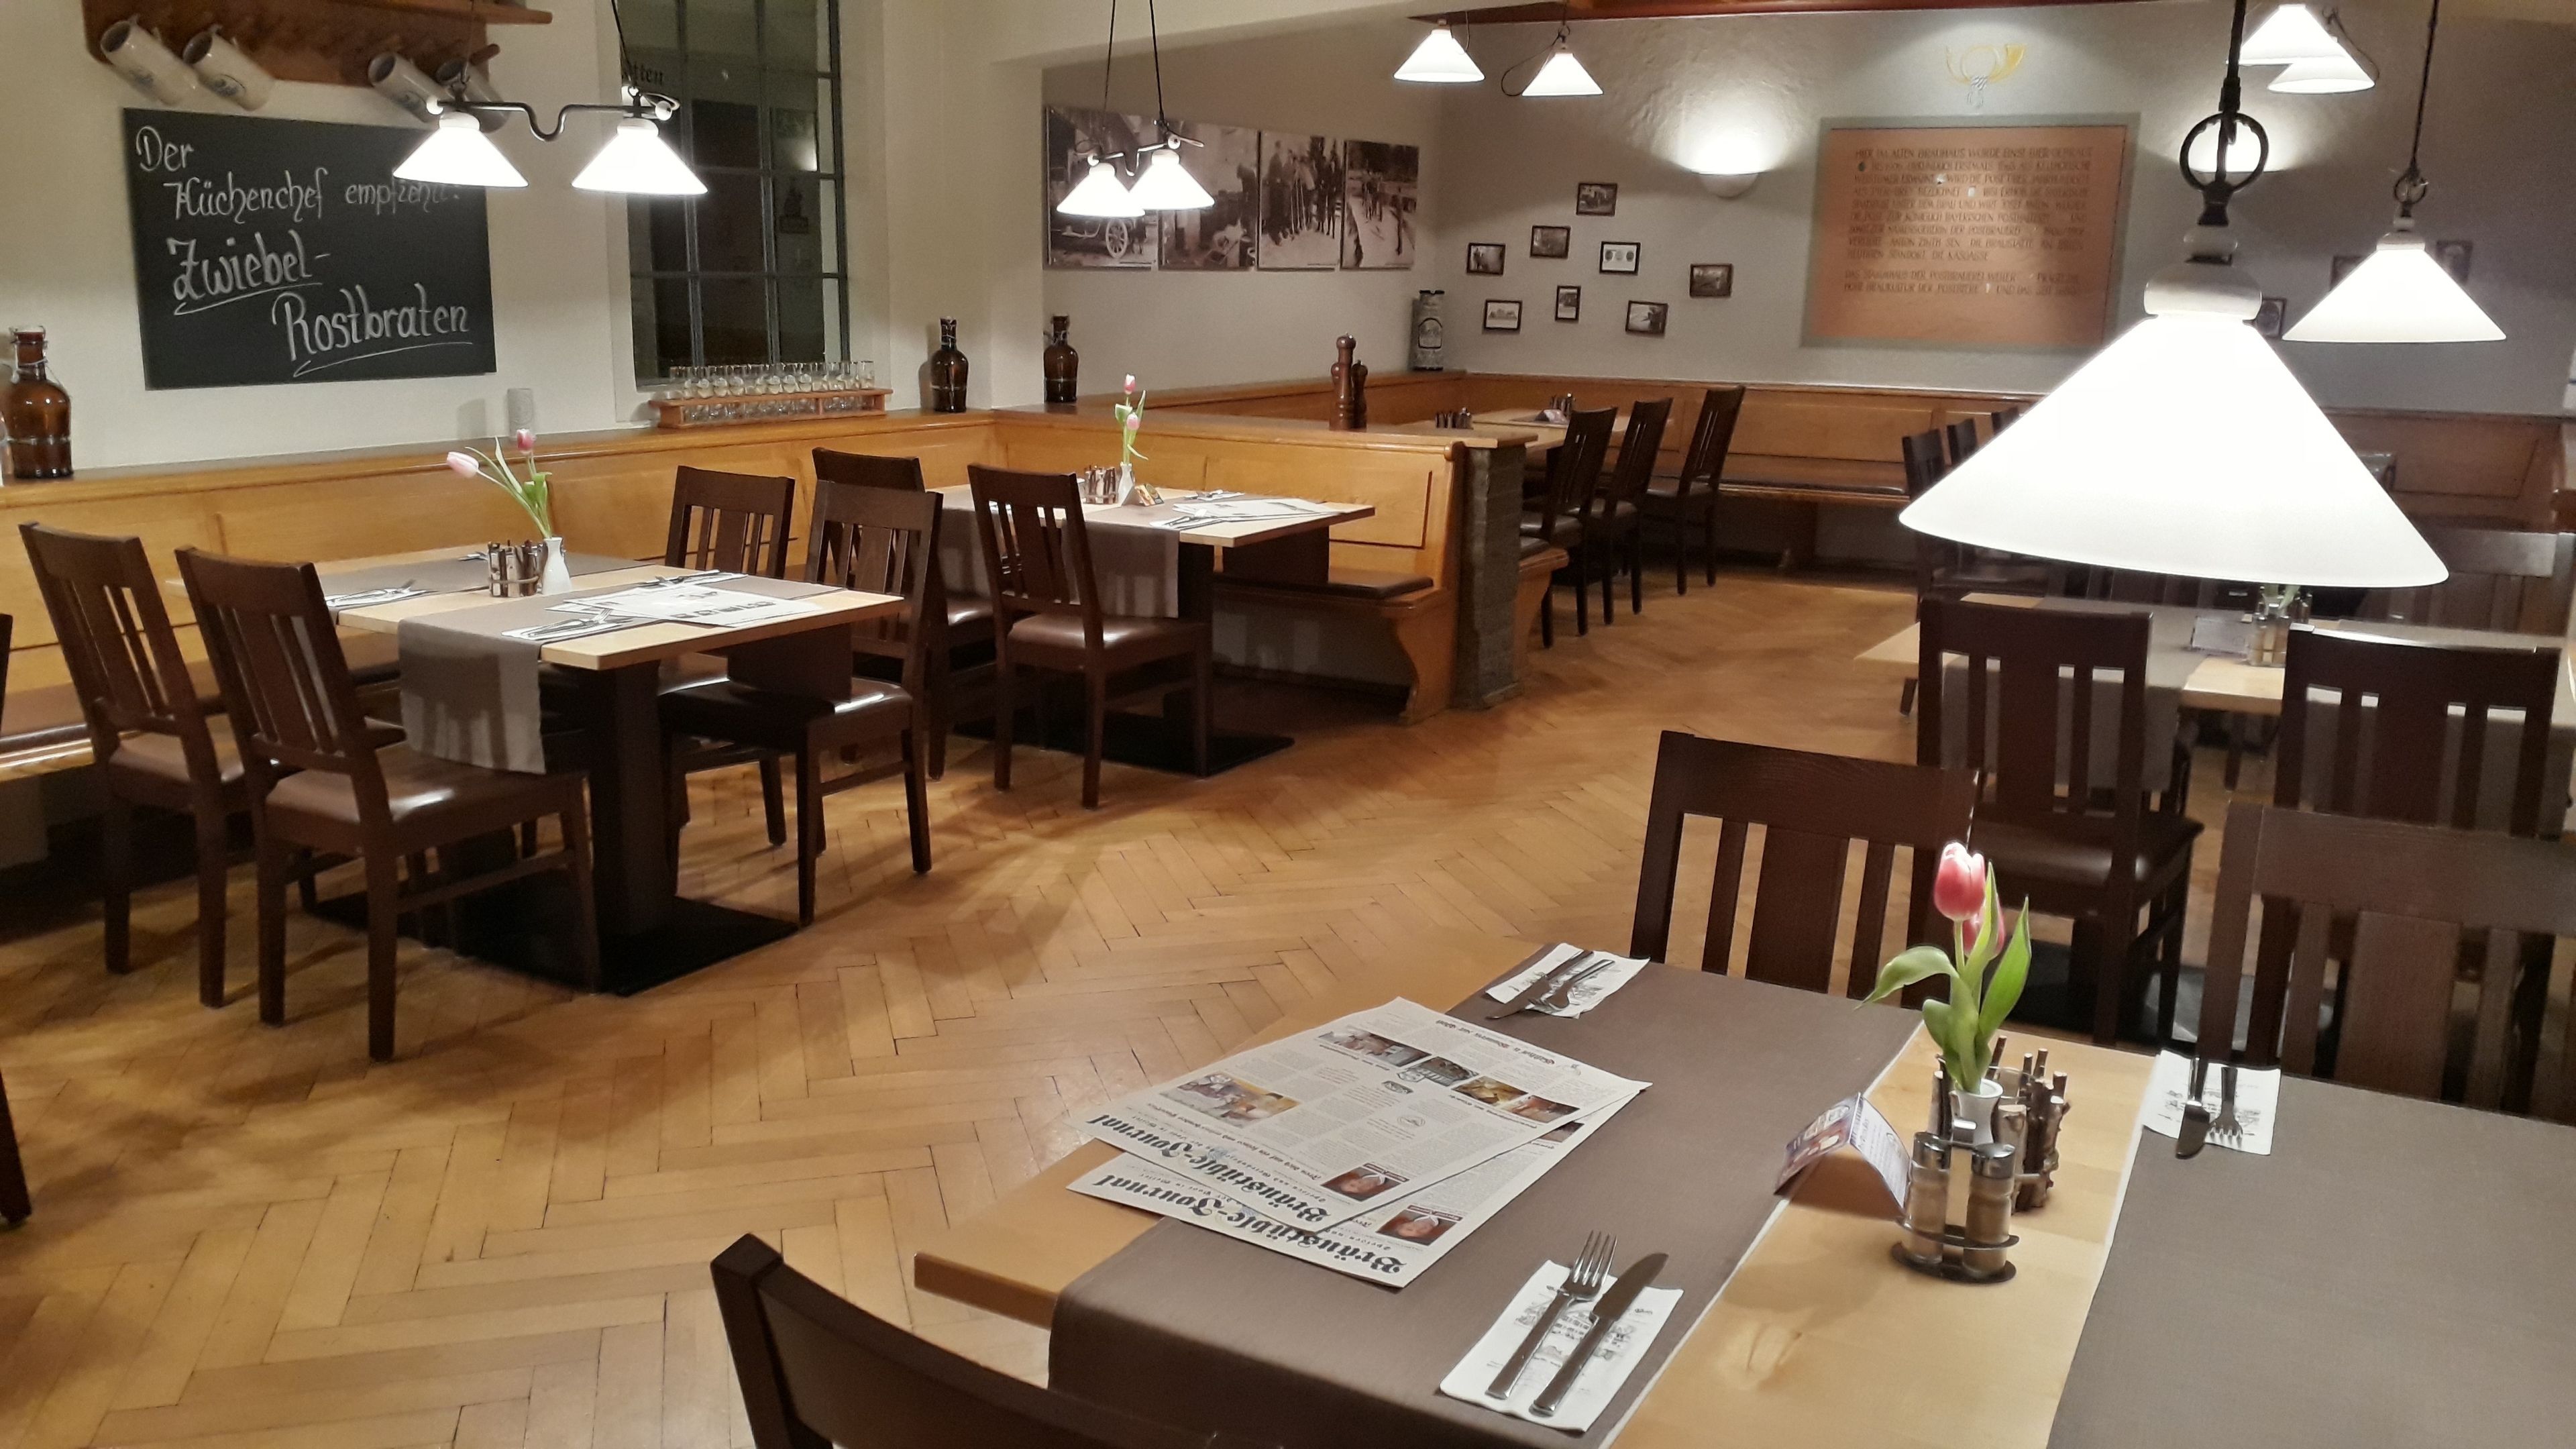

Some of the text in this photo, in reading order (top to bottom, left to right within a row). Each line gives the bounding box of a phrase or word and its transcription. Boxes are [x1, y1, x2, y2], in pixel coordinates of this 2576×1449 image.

[136, 125, 195, 171] Der
[163, 166, 329, 224] Küchenchef
[166, 229, 331, 300] Zwiebel-
[272, 283, 470, 362] Rostbraten
[1085, 1114, 1331, 1224] Bräustüble-Journal
[1092, 1175, 1407, 1275] Bräustüble-Journal
